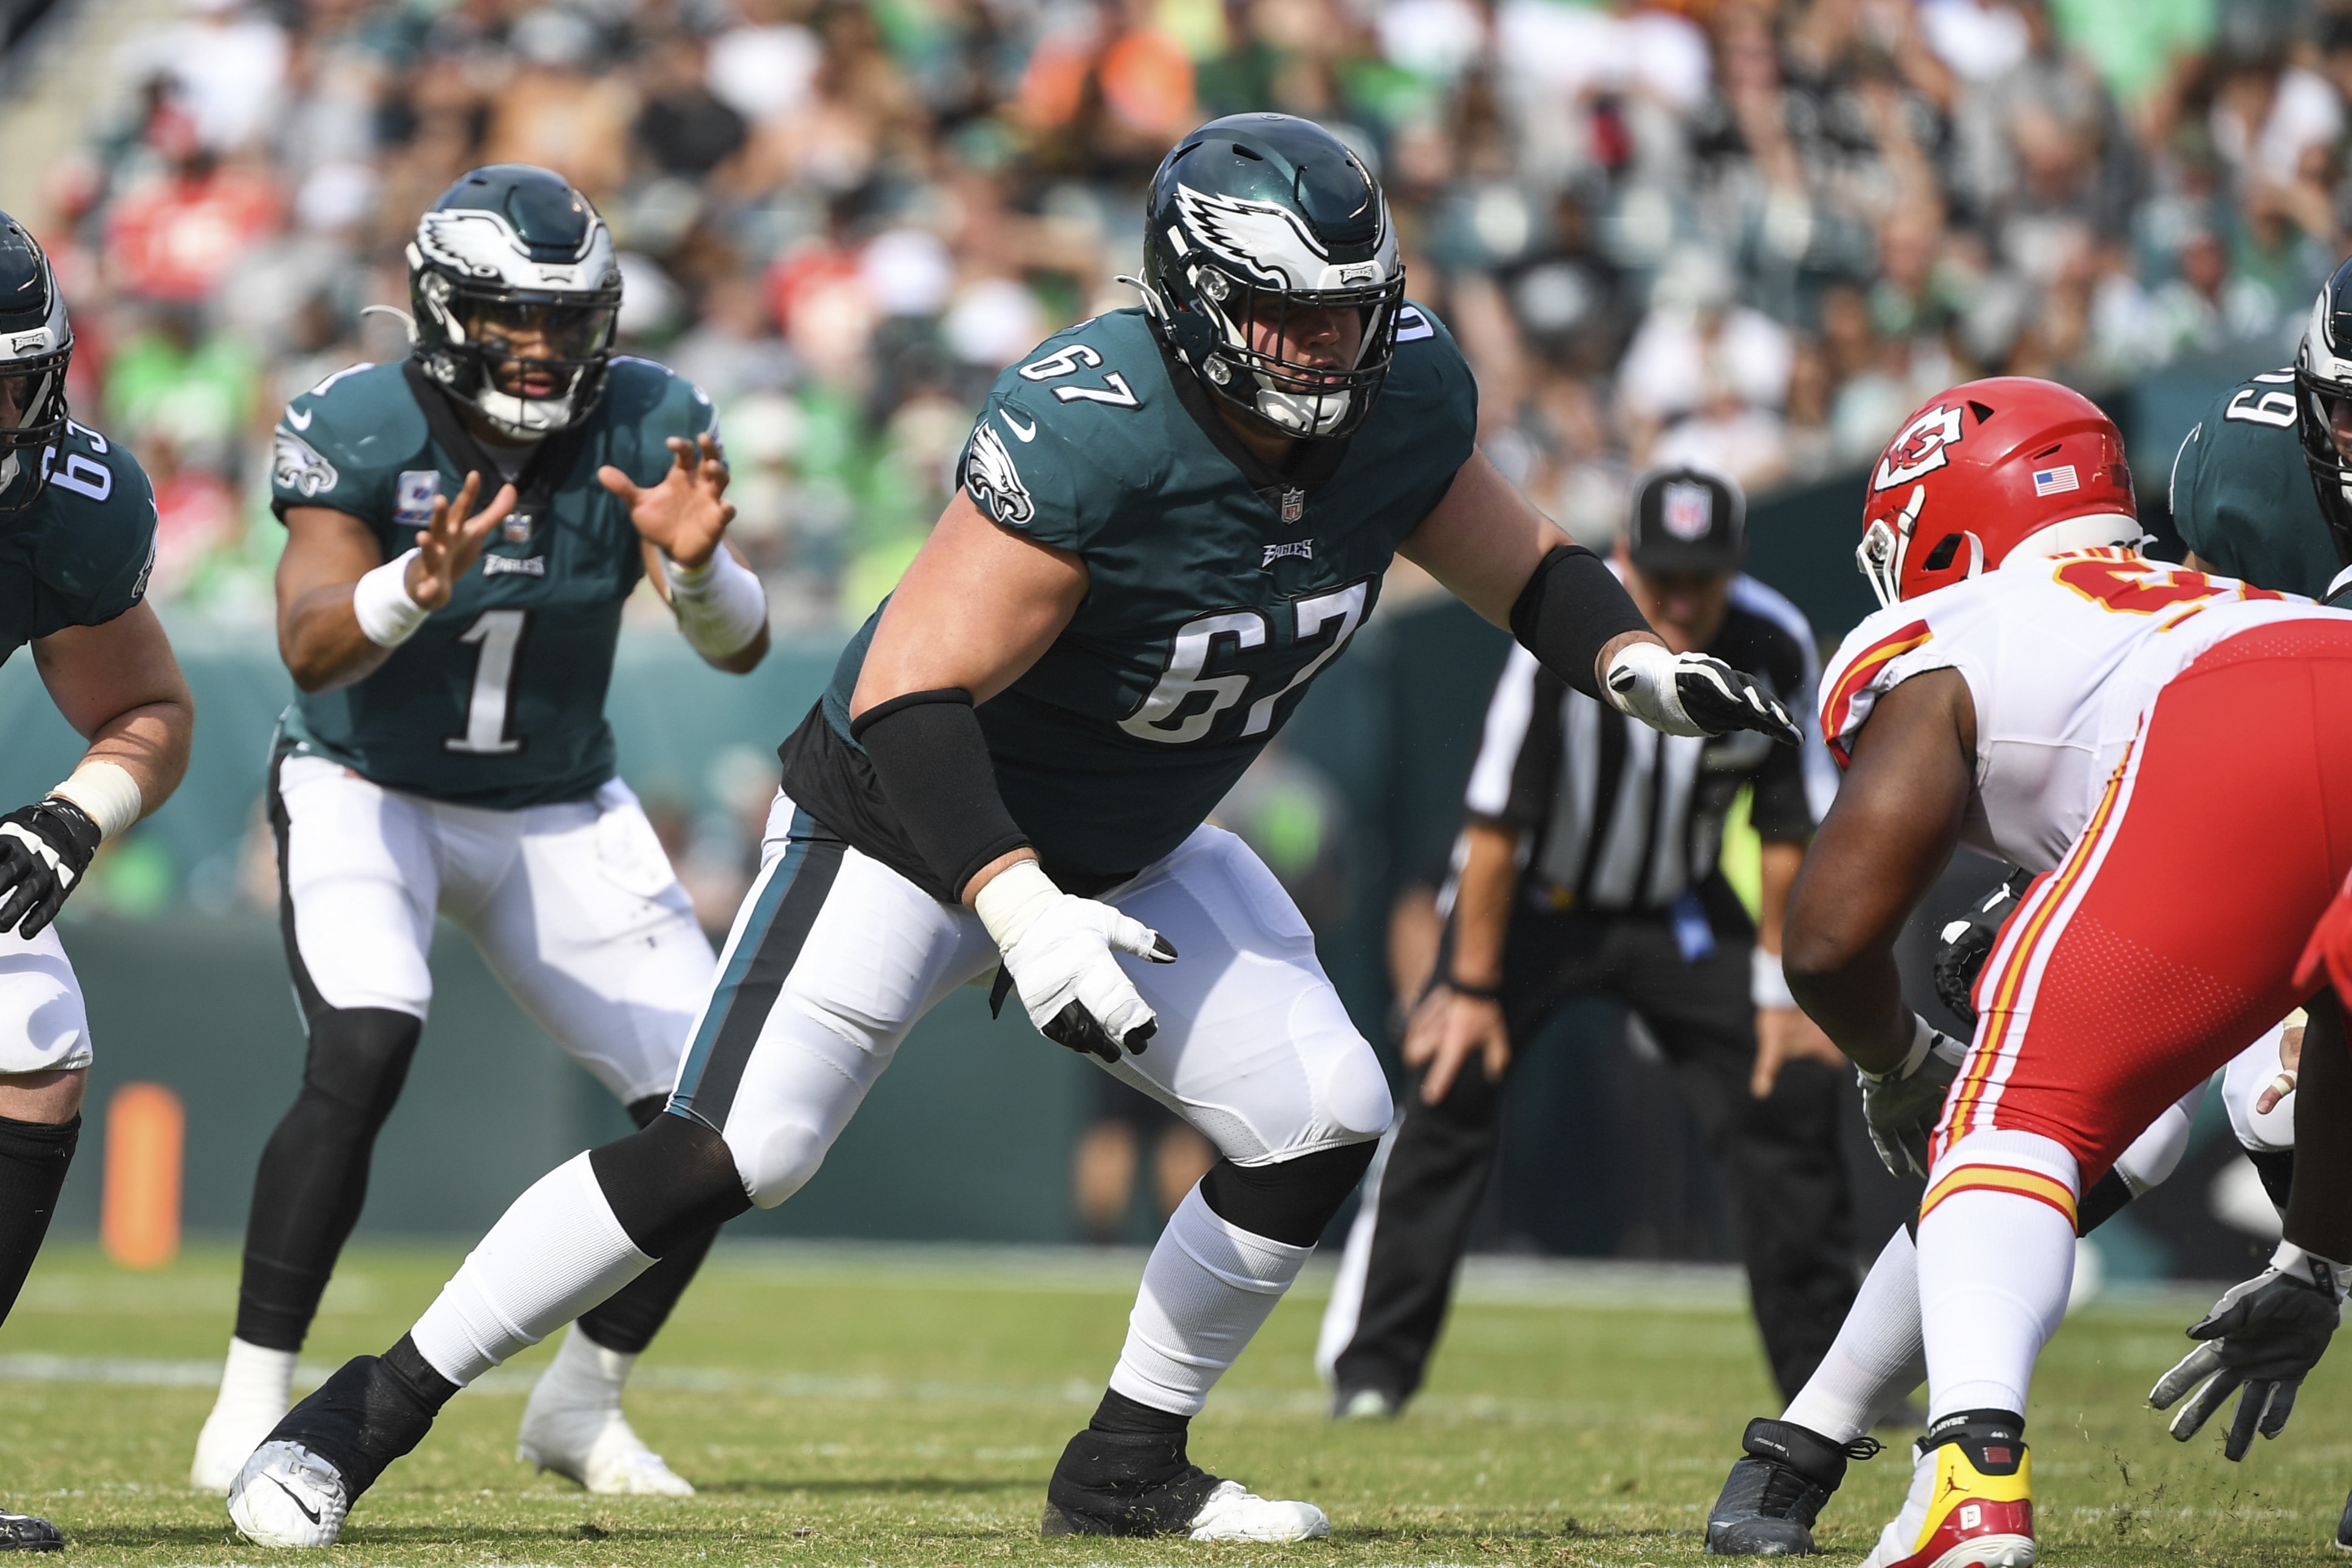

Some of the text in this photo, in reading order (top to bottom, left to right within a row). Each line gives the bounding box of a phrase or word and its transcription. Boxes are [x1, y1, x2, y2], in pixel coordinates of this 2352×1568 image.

[1019, 344, 1140, 407] 67
[1261, 539, 1315, 567] EAGLES
[445, 610, 526, 752] 1
[1117, 580, 1369, 745] 67
